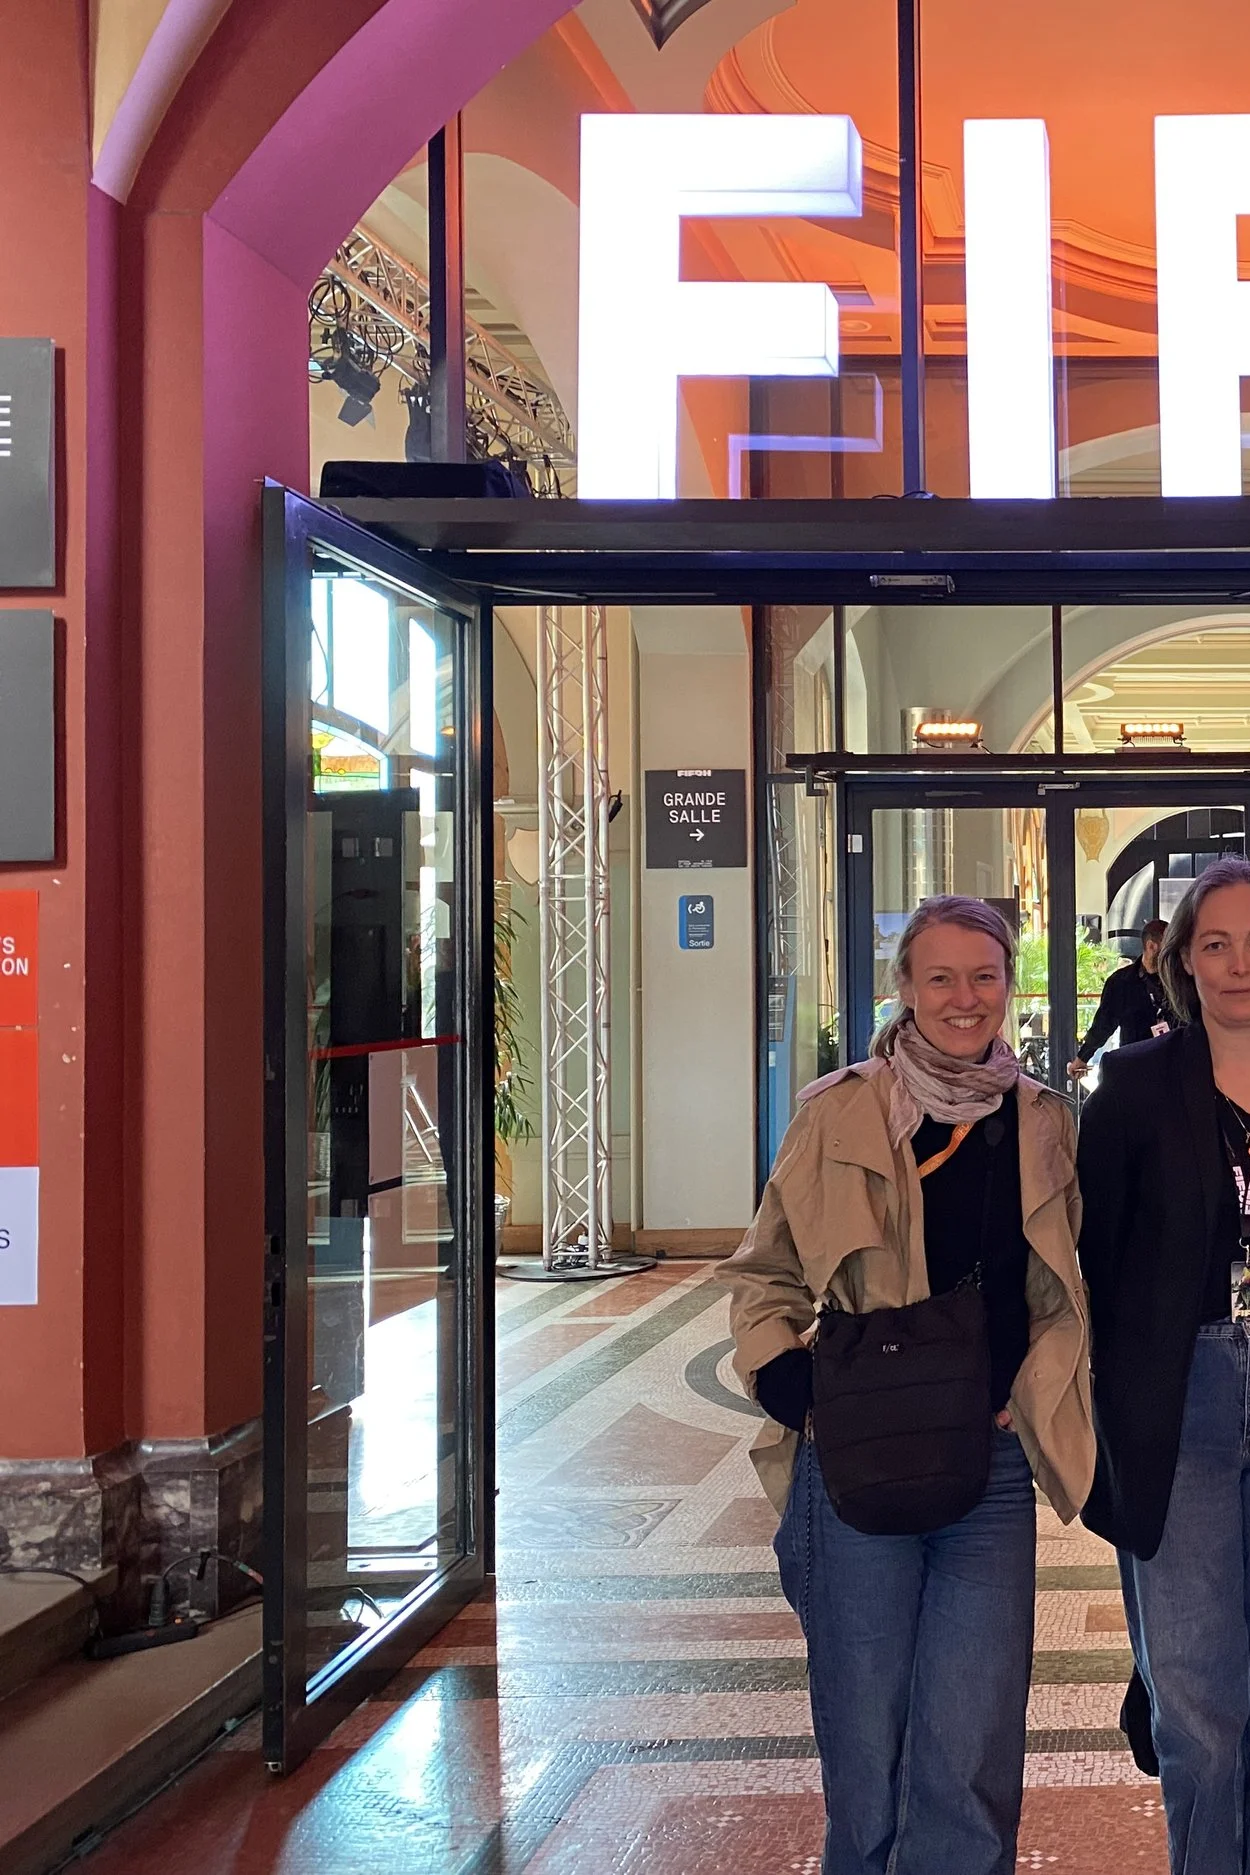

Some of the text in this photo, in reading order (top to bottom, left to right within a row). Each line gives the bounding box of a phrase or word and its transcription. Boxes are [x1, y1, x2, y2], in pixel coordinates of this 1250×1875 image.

[663, 792, 726, 807] GRANDE
[669, 809, 721, 823] SALLE
[688, 940, 711, 948] Sortie
